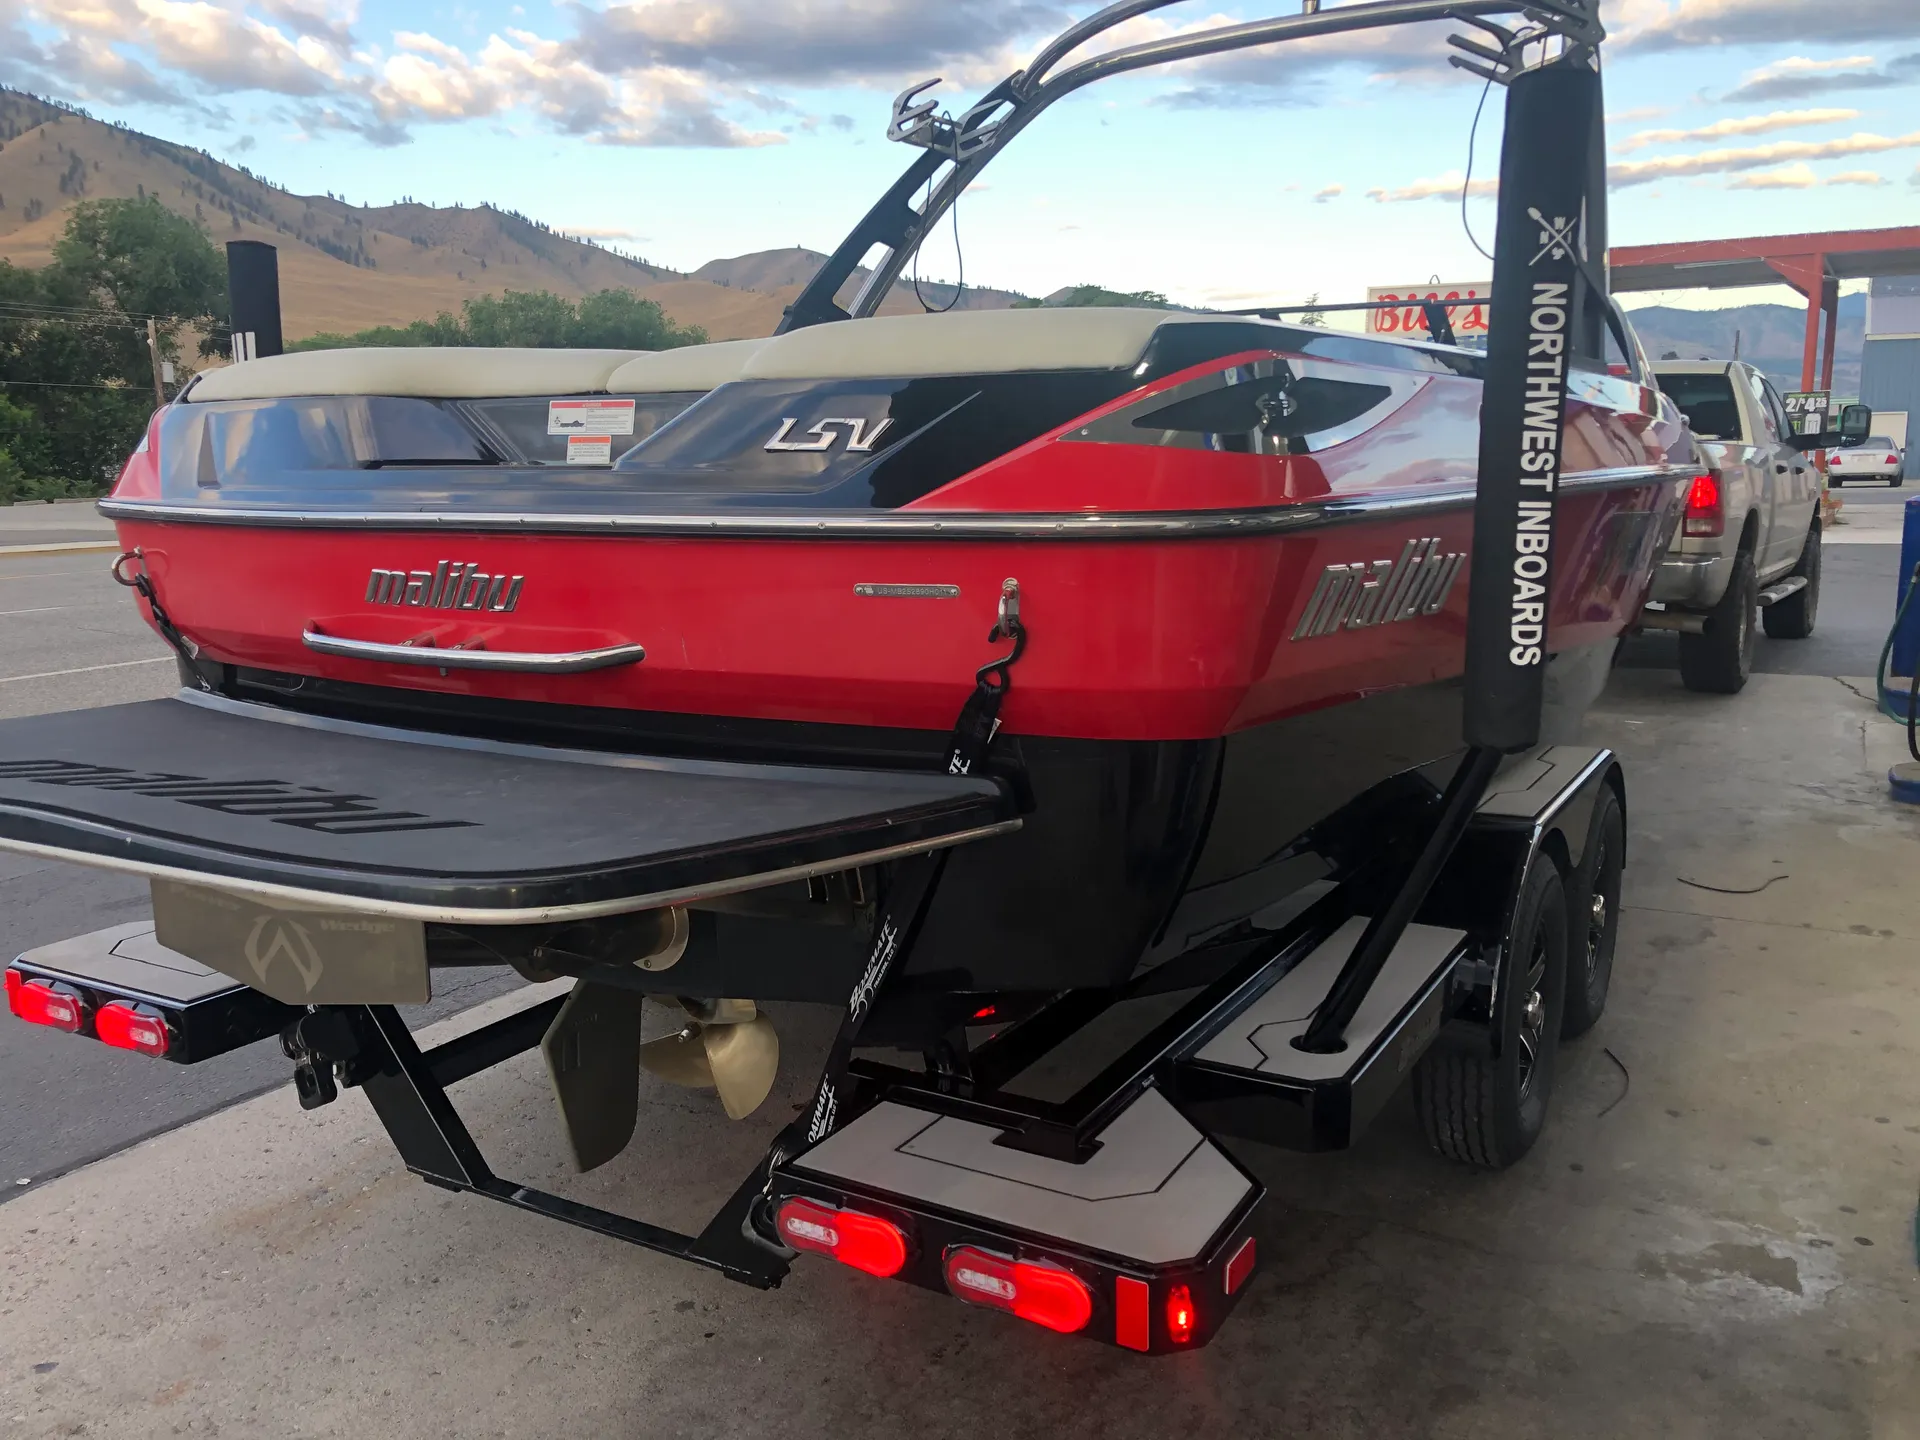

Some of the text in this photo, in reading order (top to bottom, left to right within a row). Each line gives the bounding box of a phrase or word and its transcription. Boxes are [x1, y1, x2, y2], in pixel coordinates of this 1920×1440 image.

[763, 417, 895, 451] LSV
[1509, 283, 1568, 666] NORTHWEST INBOARDS
[365, 560, 524, 612] malibu
[1288, 537, 1467, 641] malibu
[808, 1077, 829, 1143] OATMATE
